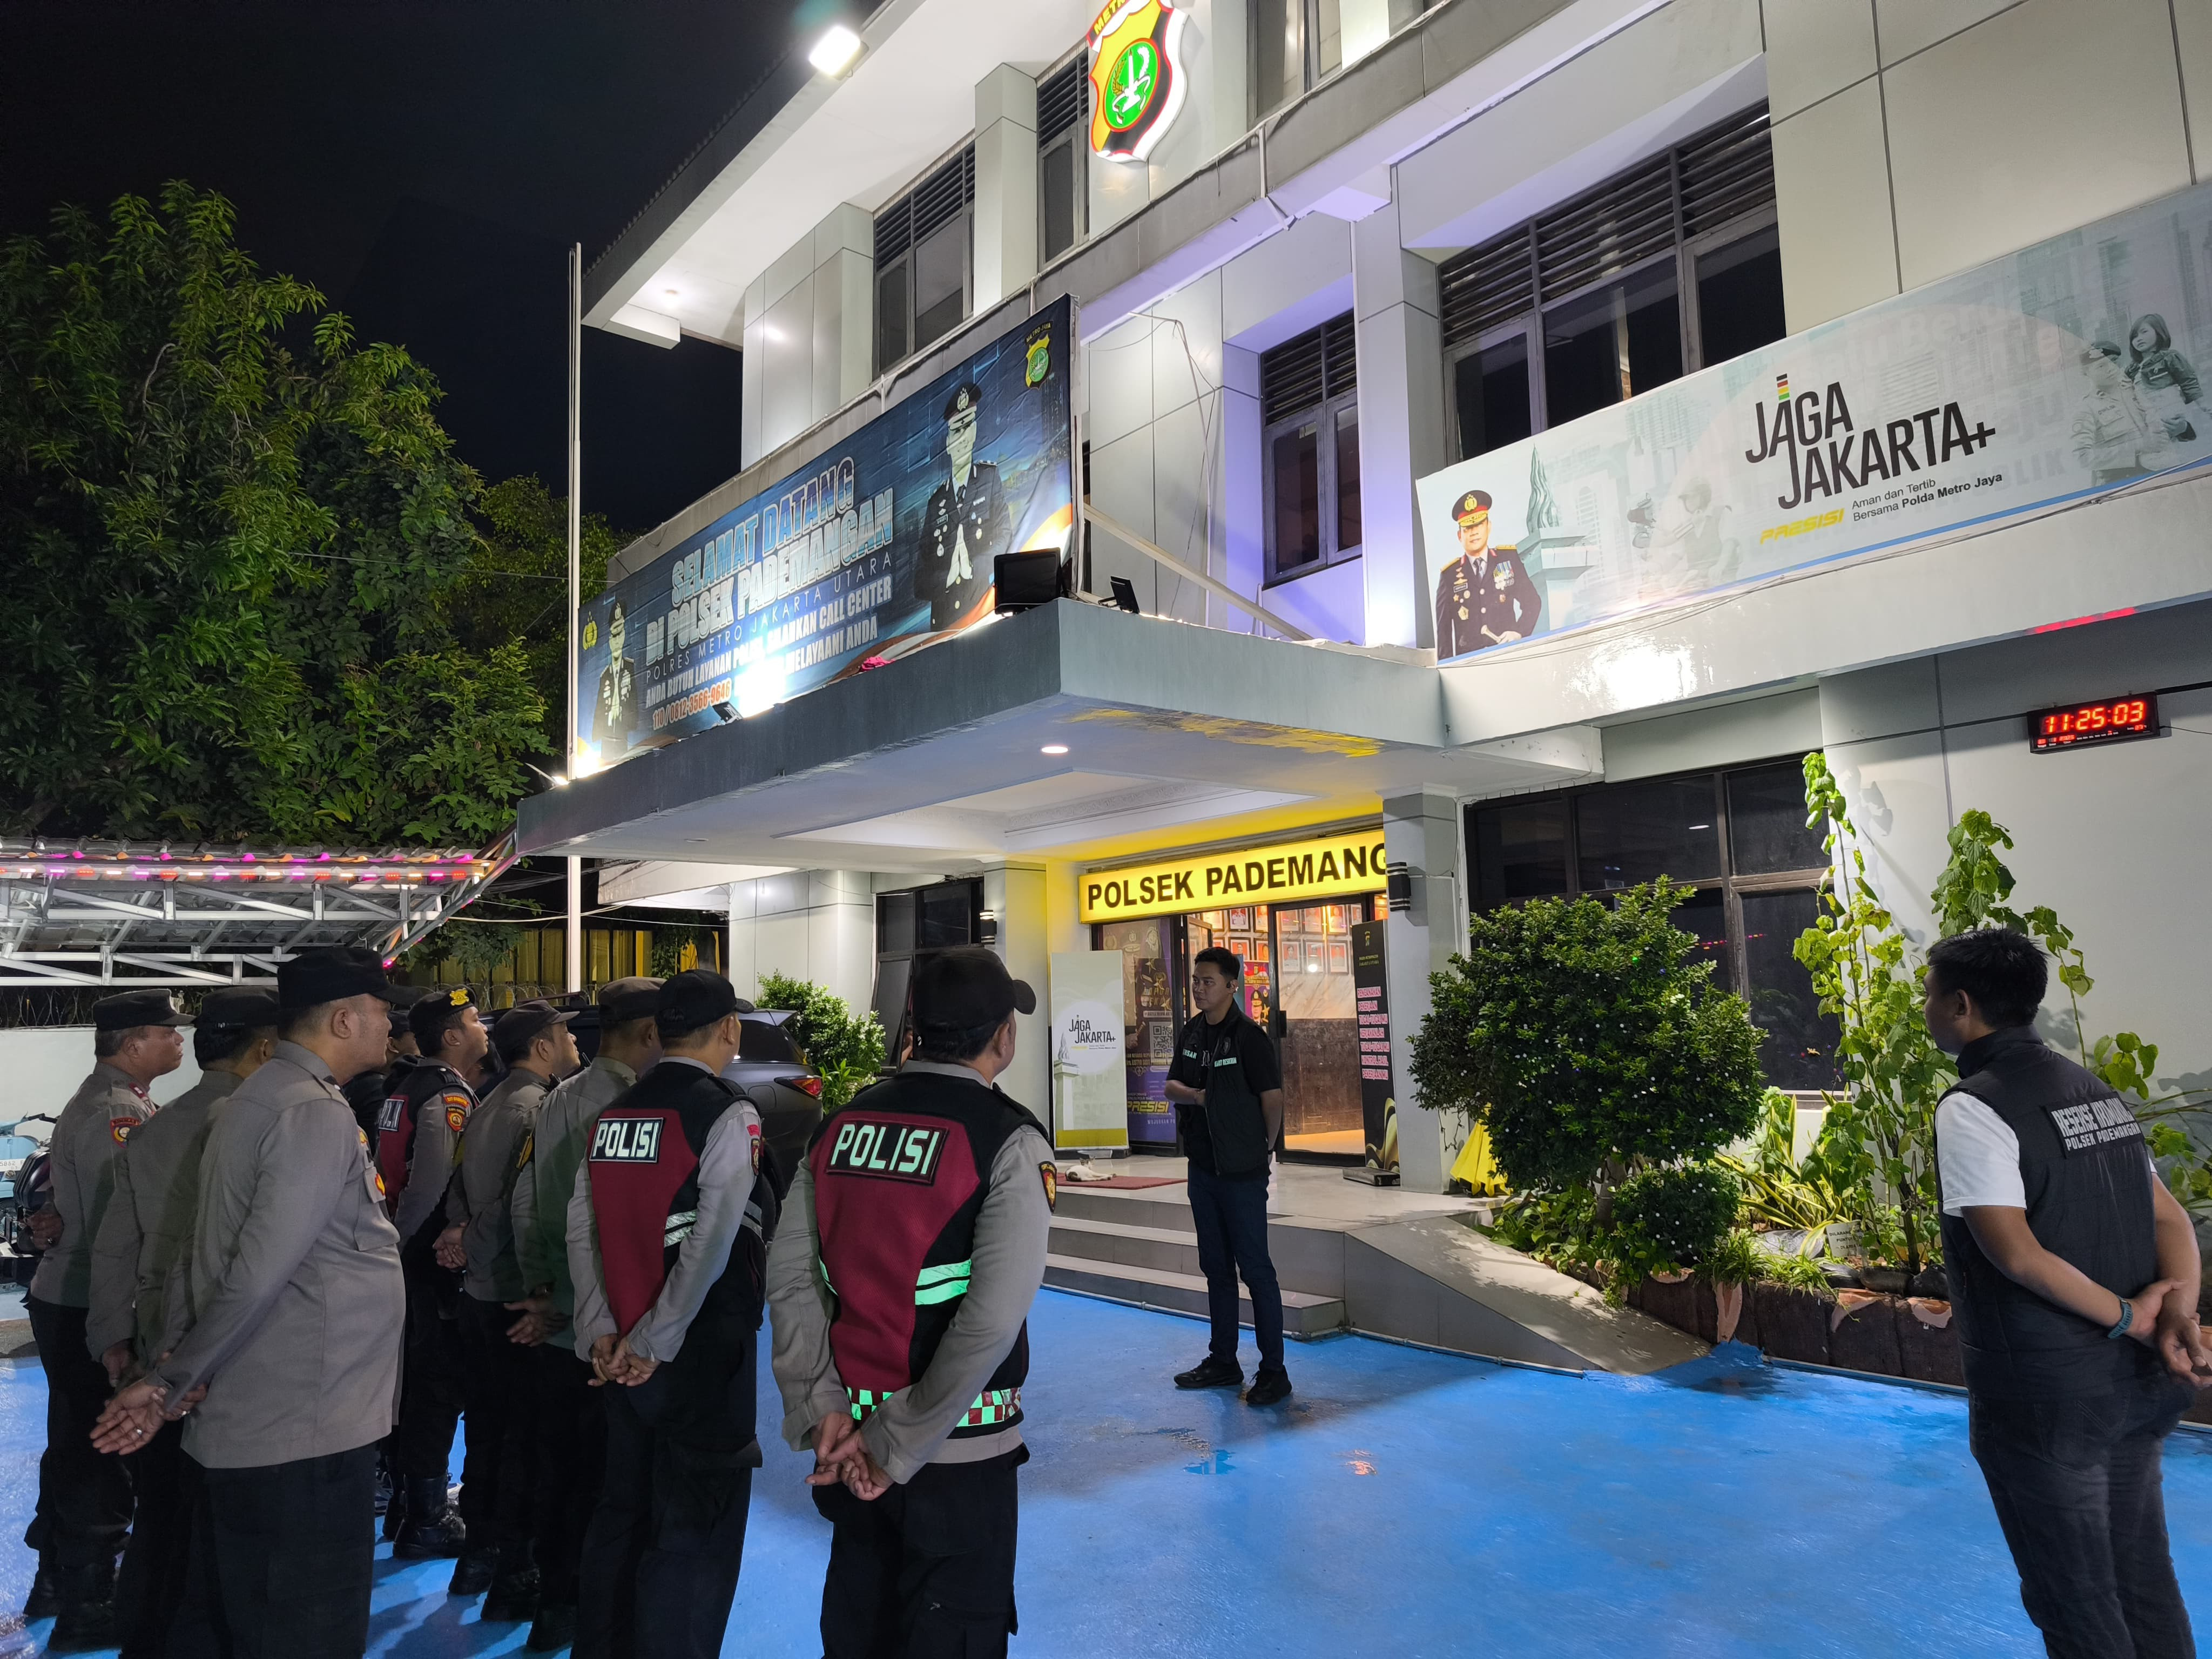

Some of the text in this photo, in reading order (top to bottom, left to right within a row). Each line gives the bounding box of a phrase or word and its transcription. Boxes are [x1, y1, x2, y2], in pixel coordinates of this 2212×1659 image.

[1745, 377, 1853, 463] JAGA
[1852, 478, 1936, 510] Aman dan Tertib
[1853, 474, 2003, 522] Bersama Polda Metro Jaya
[672, 456, 854, 608] SELAMAT DATANG
[1759, 508, 1845, 544] PRESISI
[646, 488, 893, 666] DI POLSEK PADEMANGAN
[646, 651, 690, 684] POLRES
[698, 625, 742, 659] METRO
[752, 586, 821, 633] JAKARTA
[834, 552, 891, 593] UTARA
[846, 616, 878, 650] ANDA
[646, 684, 666, 709] ANDA
[667, 671, 693, 698] BUTUH
[696, 651, 731, 686] LAYANAN
[819, 598, 845, 629] CALL
[847, 575, 892, 616] CENTER
[2045, 701, 2144, 733] 11:25:03
[1088, 870, 1194, 911] POLSEK
[1069, 1019, 1091, 1032] JAGA
[2051, 1103, 2099, 1137] RESERSE
[2064, 1122, 2141, 1151] POLSEK PADEMANGAN
[592, 1122, 659, 1157] POLISI
[831, 1123, 940, 1175] POLISI
